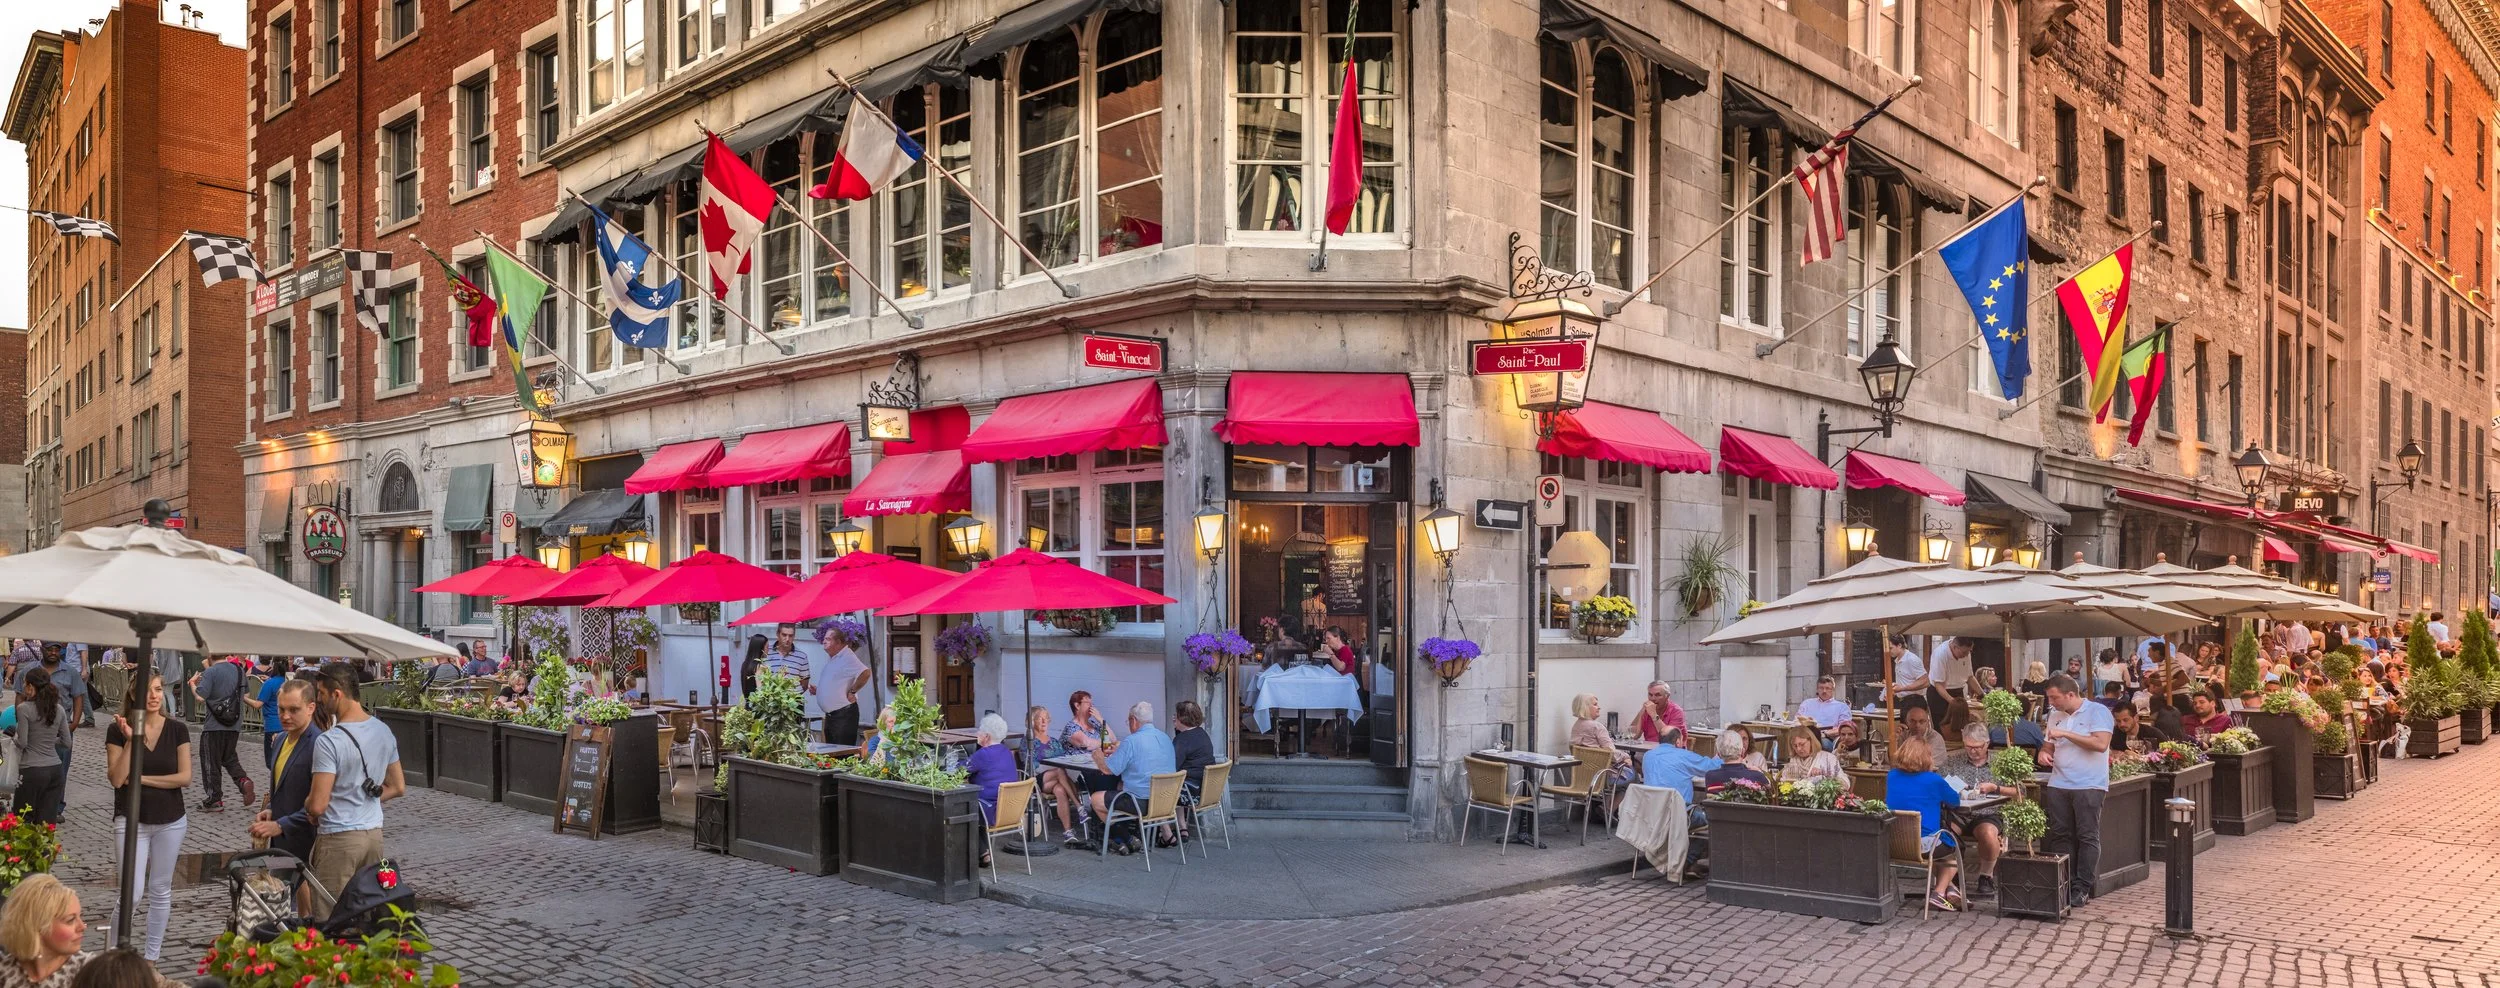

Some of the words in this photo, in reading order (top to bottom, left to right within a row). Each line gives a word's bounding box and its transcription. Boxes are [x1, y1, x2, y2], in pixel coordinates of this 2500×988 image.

[1525, 326, 1554, 338] Solmar
[1118, 343, 1129, 351] Rue
[1095, 348, 1152, 366] Saint-Vincent
[1498, 353, 1560, 368] Saint-Paul
[531, 431, 567, 448] SOLMAR
[865, 500, 875, 511] La
[876, 497, 913, 513] Sauvagine
[2294, 497, 2324, 509] BEVO
[310, 549, 343, 558] BRASSEURS
